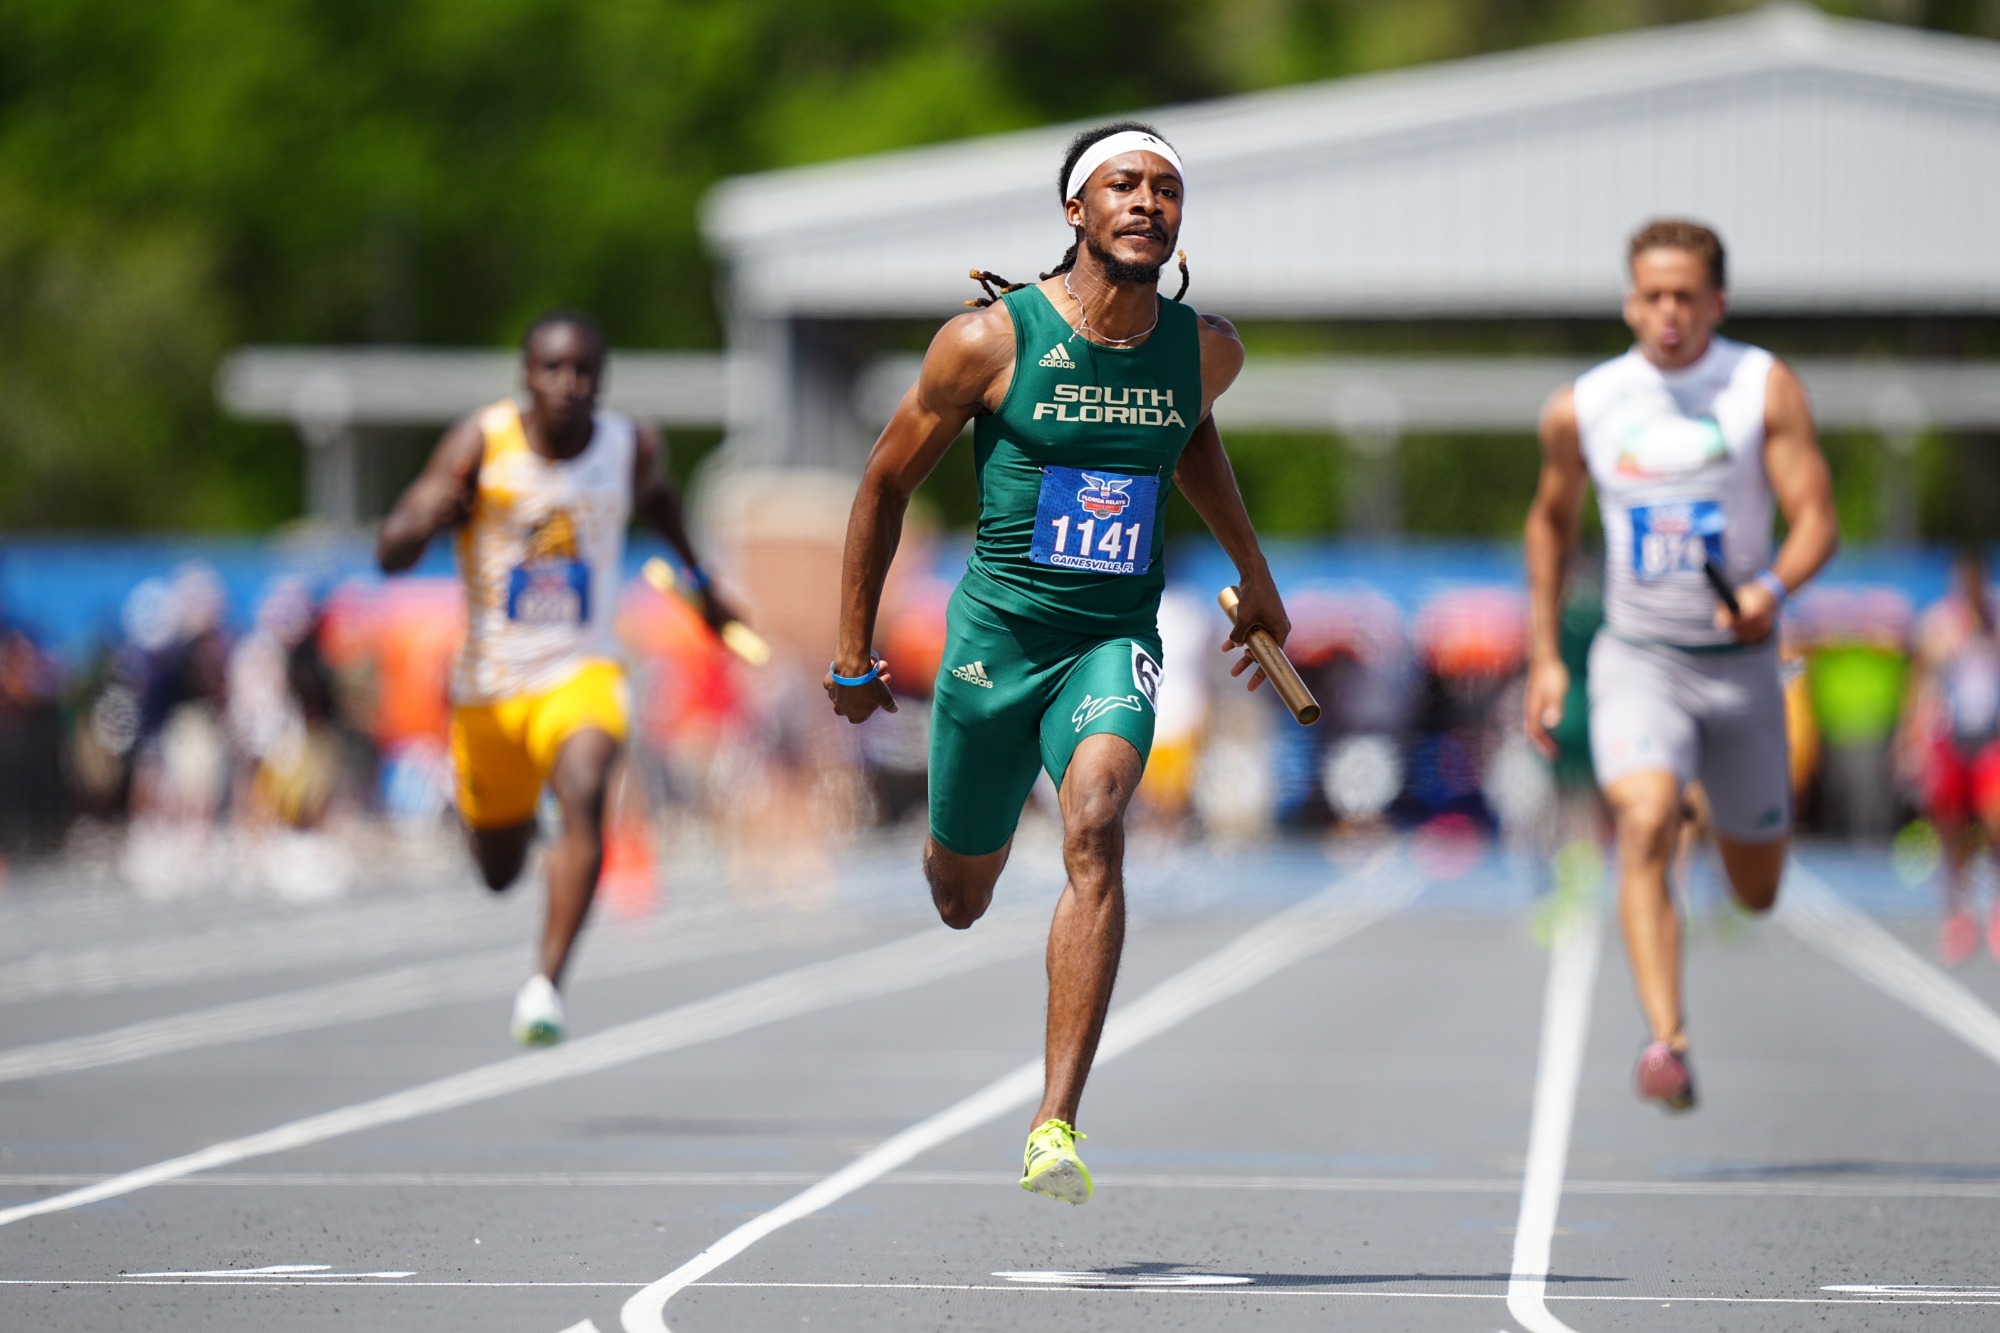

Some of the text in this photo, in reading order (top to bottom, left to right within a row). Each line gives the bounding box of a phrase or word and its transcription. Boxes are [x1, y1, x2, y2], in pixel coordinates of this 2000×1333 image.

[1039, 358, 1075, 369] adidas
[1053, 384, 1174, 407] SOUTH
[1032, 402, 1186, 428] FLORIDA
[1081, 494, 1105, 504] FLORIDA
[1052, 515, 1140, 560] 1141
[1050, 554, 1134, 573] GAINESVILLE, FL
[951, 668, 994, 689] adidas
